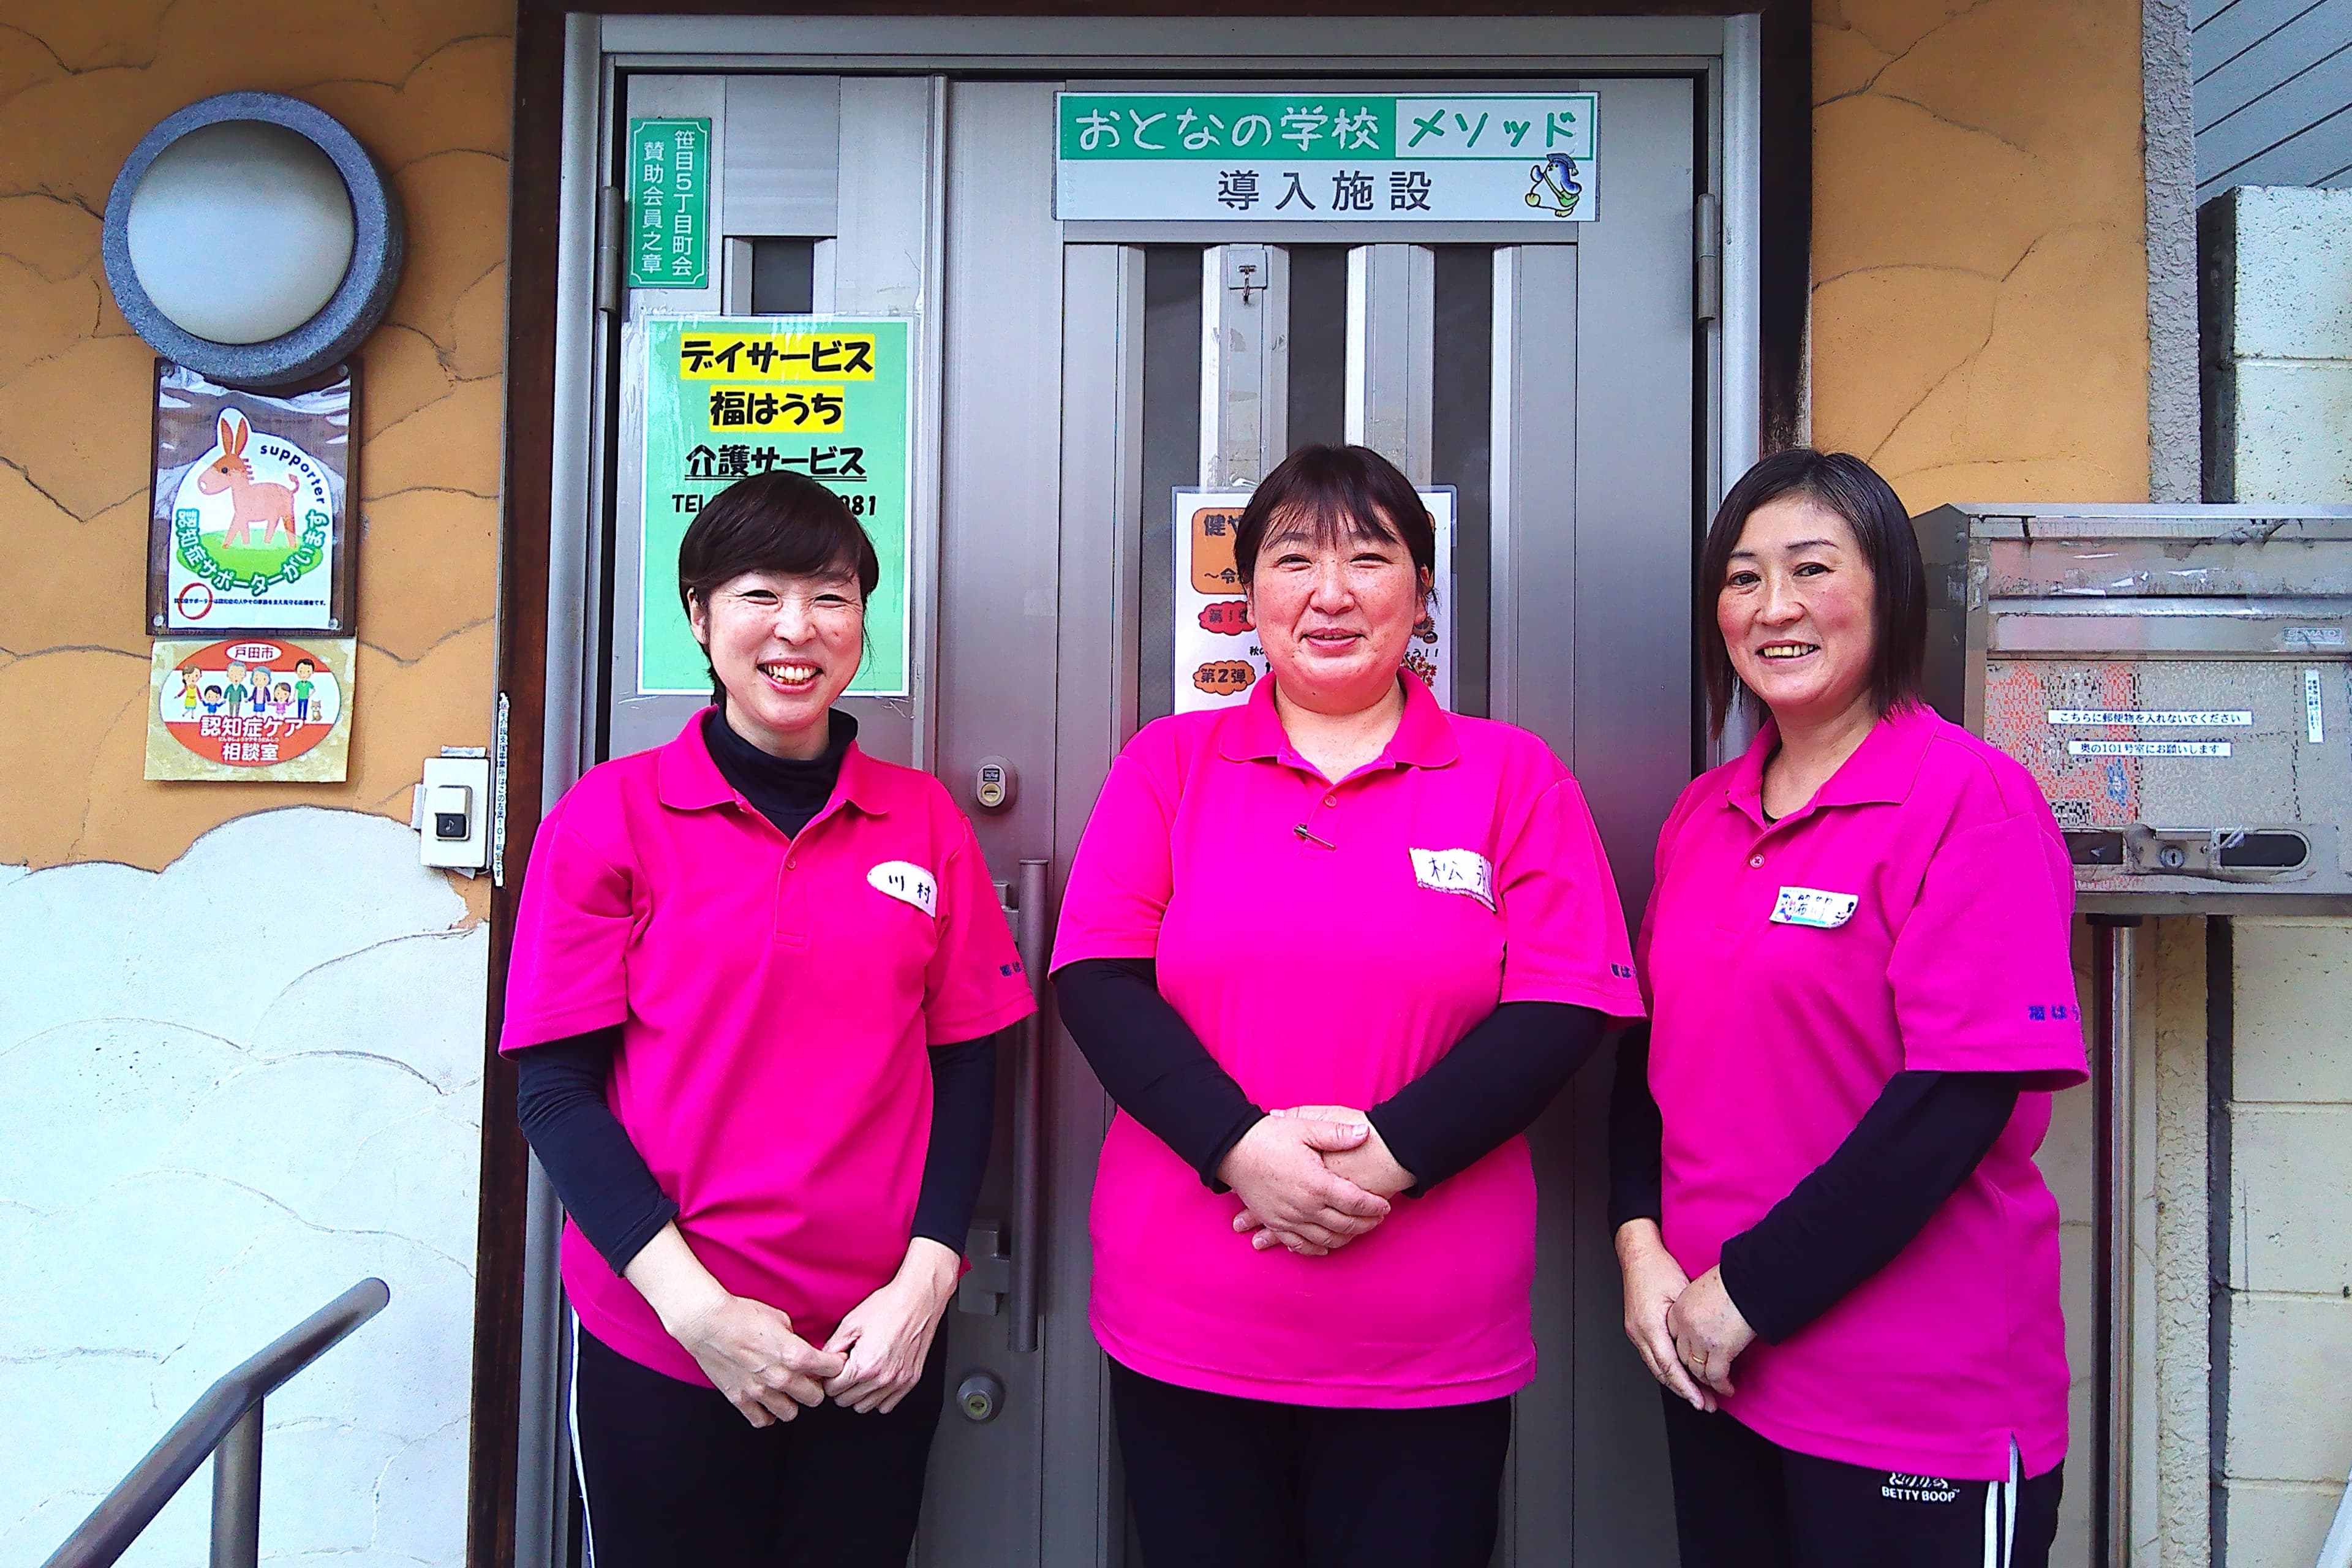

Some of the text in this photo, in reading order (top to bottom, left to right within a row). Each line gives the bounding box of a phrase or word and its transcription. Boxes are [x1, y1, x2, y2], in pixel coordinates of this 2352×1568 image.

[1076, 106, 1578, 152] おとなの学校 メソッド
[671, 129, 696, 277] 笹目5丁目町会
[1218, 170, 1434, 211] 導入施設
[641, 141, 665, 274] 賛助会員之章
[681, 340, 874, 373] デイサービス
[710, 391, 843, 426] 福はうち
[260, 442, 326, 504] supporter
[685, 444, 867, 477] 介護サービス
[175, 508, 331, 597] 認知症サポーターがいます
[235, 645, 274, 660] 戸田市
[1200, 668, 1246, 684] 第2弾
[200, 716, 304, 737] 認知症ケア
[2060, 712, 2241, 724] こちらに郵便物を入れないでください
[222, 742, 279, 761] 相談室
[889, 875, 931, 904] 川村
[1882, 1486, 1955, 1502] BETTY BOOP
